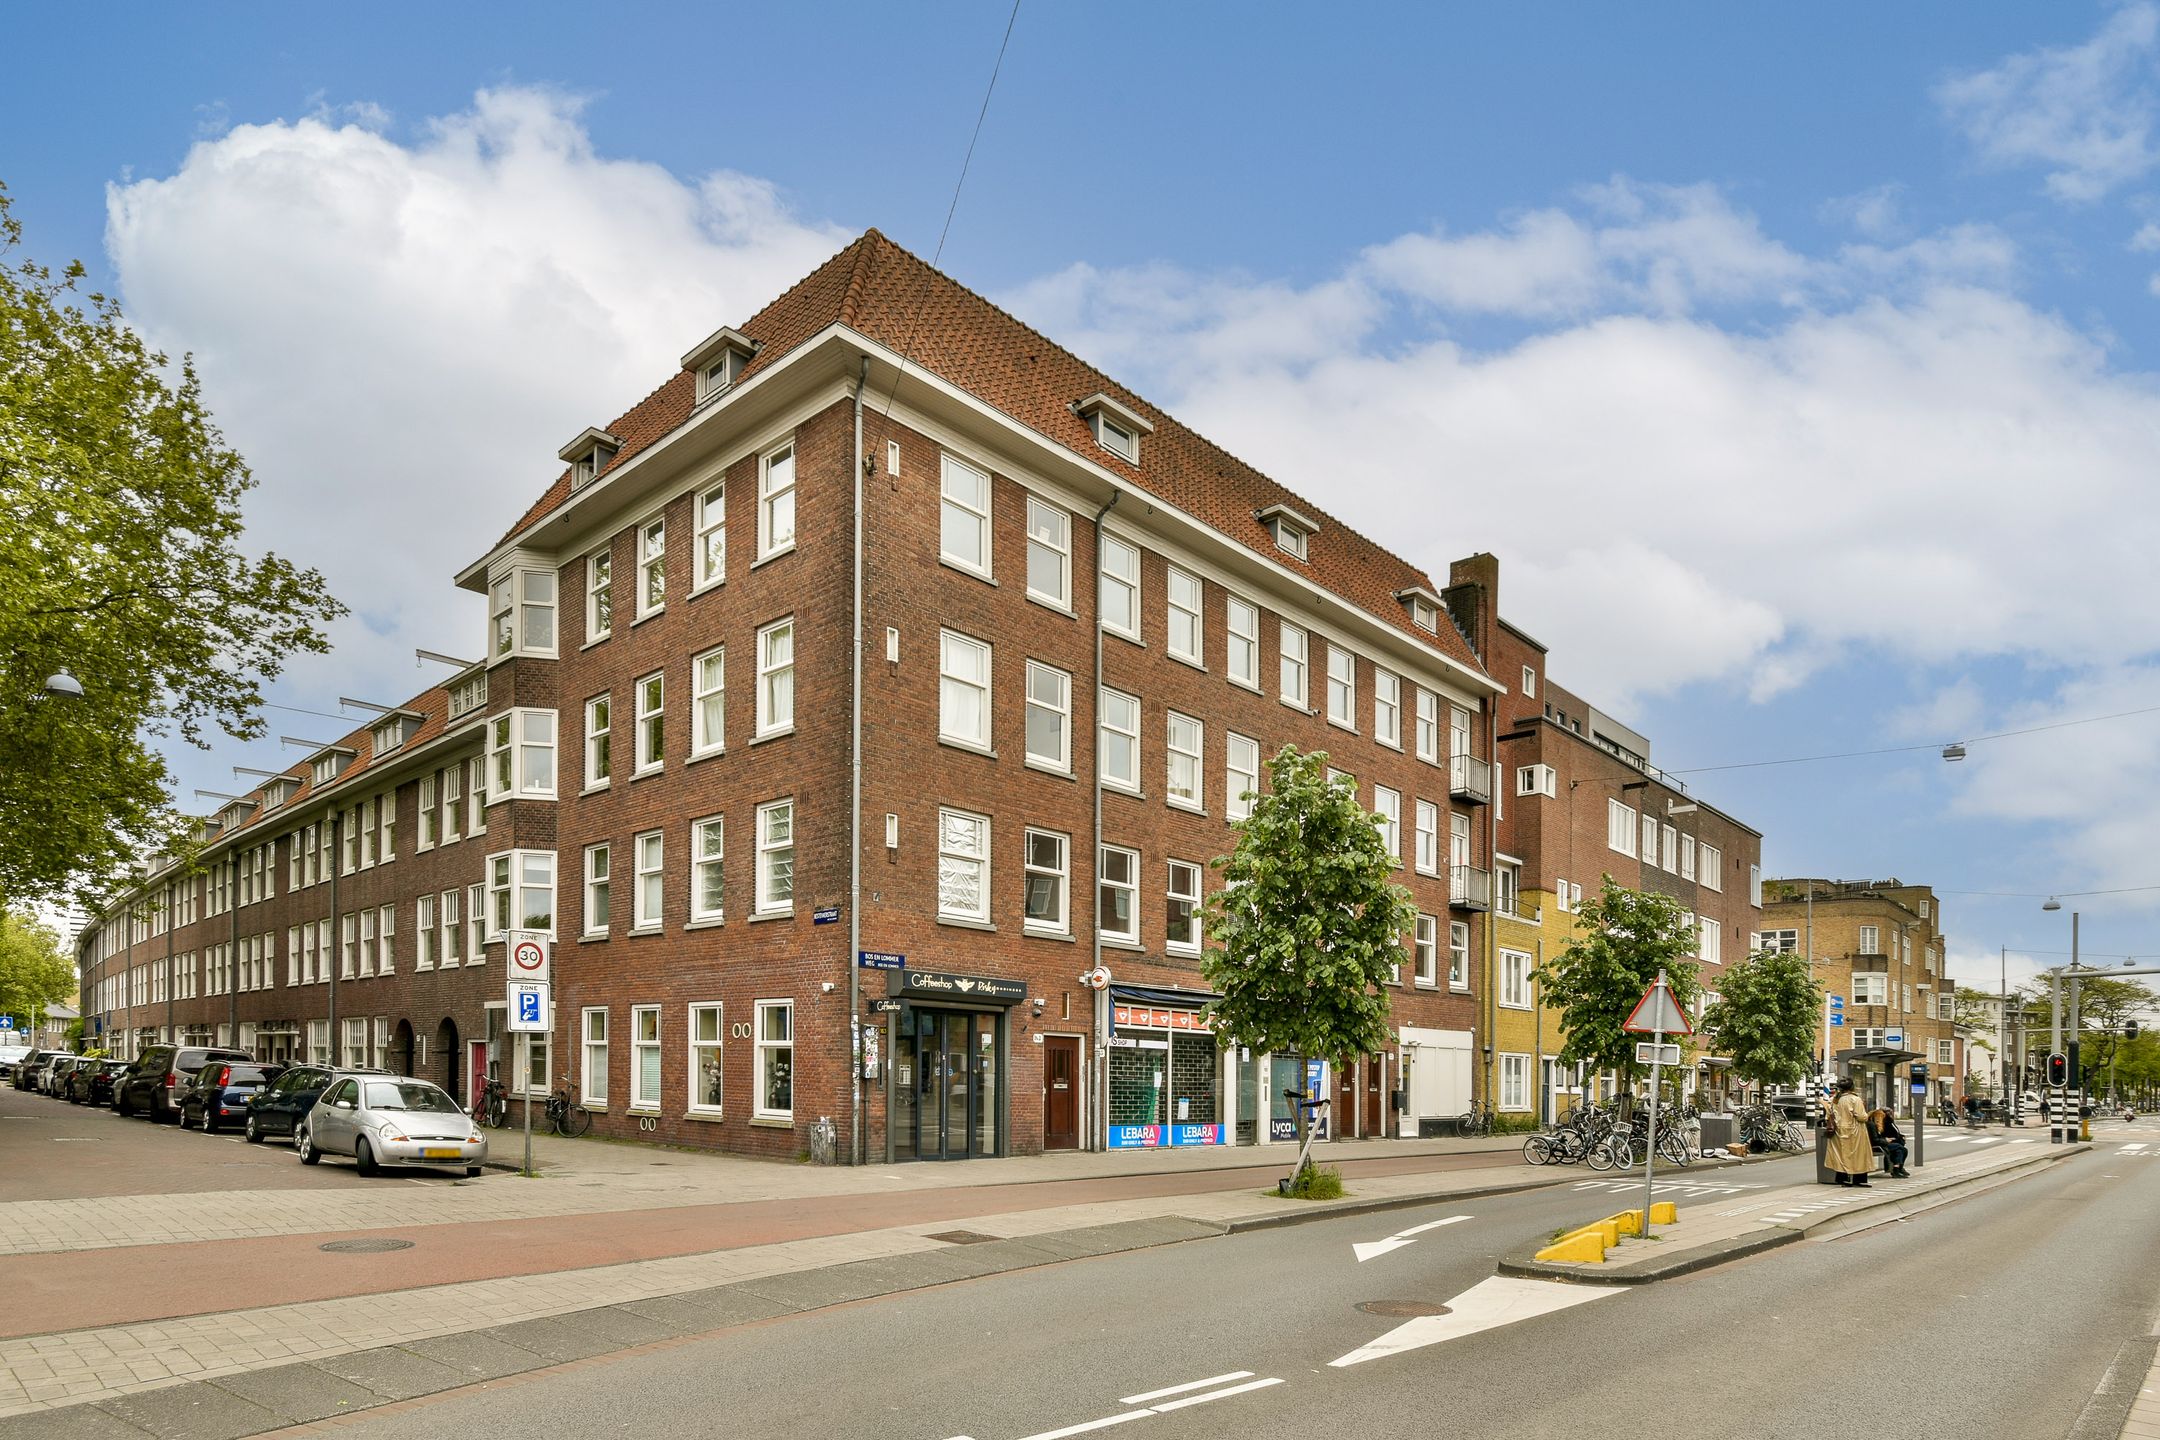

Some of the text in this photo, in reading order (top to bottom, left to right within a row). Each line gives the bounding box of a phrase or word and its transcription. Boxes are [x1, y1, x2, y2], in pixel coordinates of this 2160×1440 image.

[520, 951, 538, 961] 30
[911, 973, 953, 990] Coffeeshop
[523, 995, 535, 1009] P
[876, 1001, 901, 1011] Coffeeshop
[1121, 1127, 1155, 1140] LEBARA
[1182, 1126, 1214, 1138] LEBARA
[1272, 1120, 1292, 1135] Lyca
